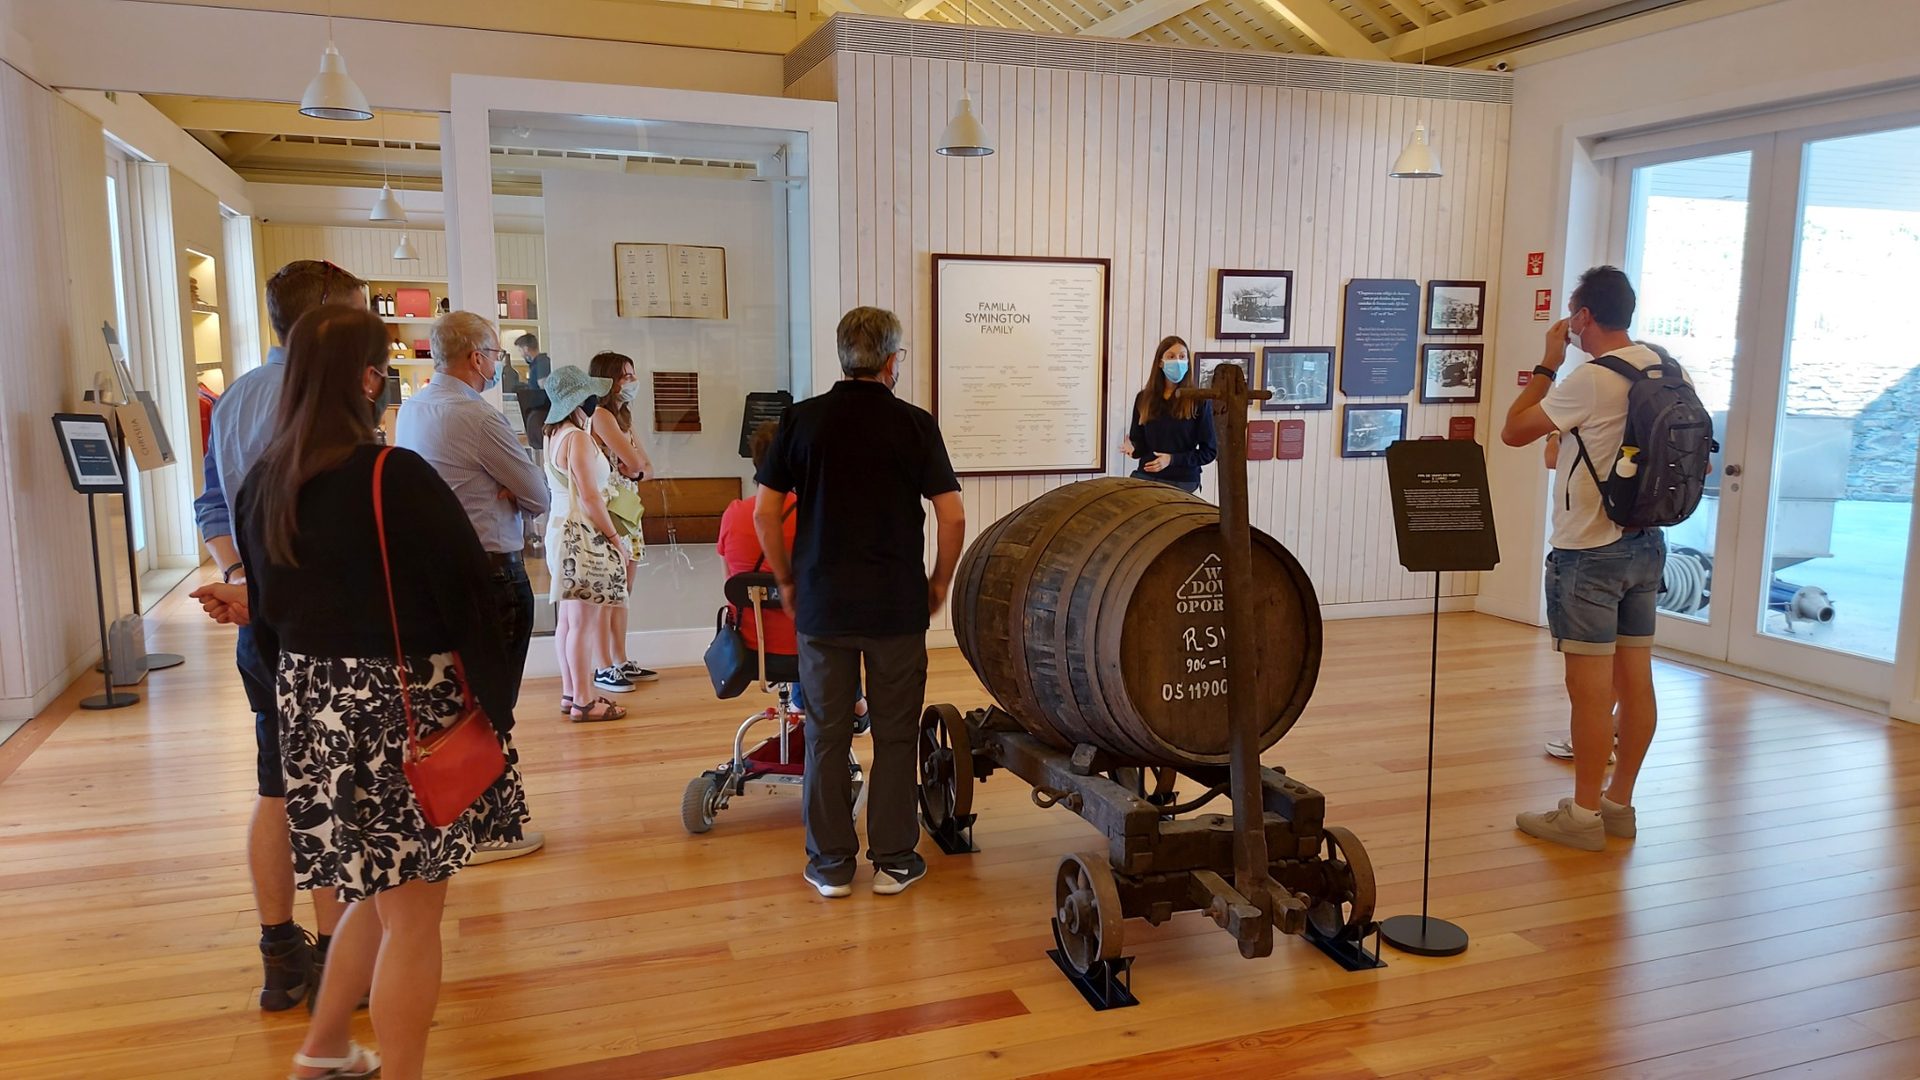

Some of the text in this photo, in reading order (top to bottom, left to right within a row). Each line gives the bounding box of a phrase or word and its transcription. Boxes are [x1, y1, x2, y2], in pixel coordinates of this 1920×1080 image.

[978, 302, 1017, 312] FAMILIA
[964, 312, 1031, 324] SYMINGTON
[980, 325, 1014, 335] FAMILY
